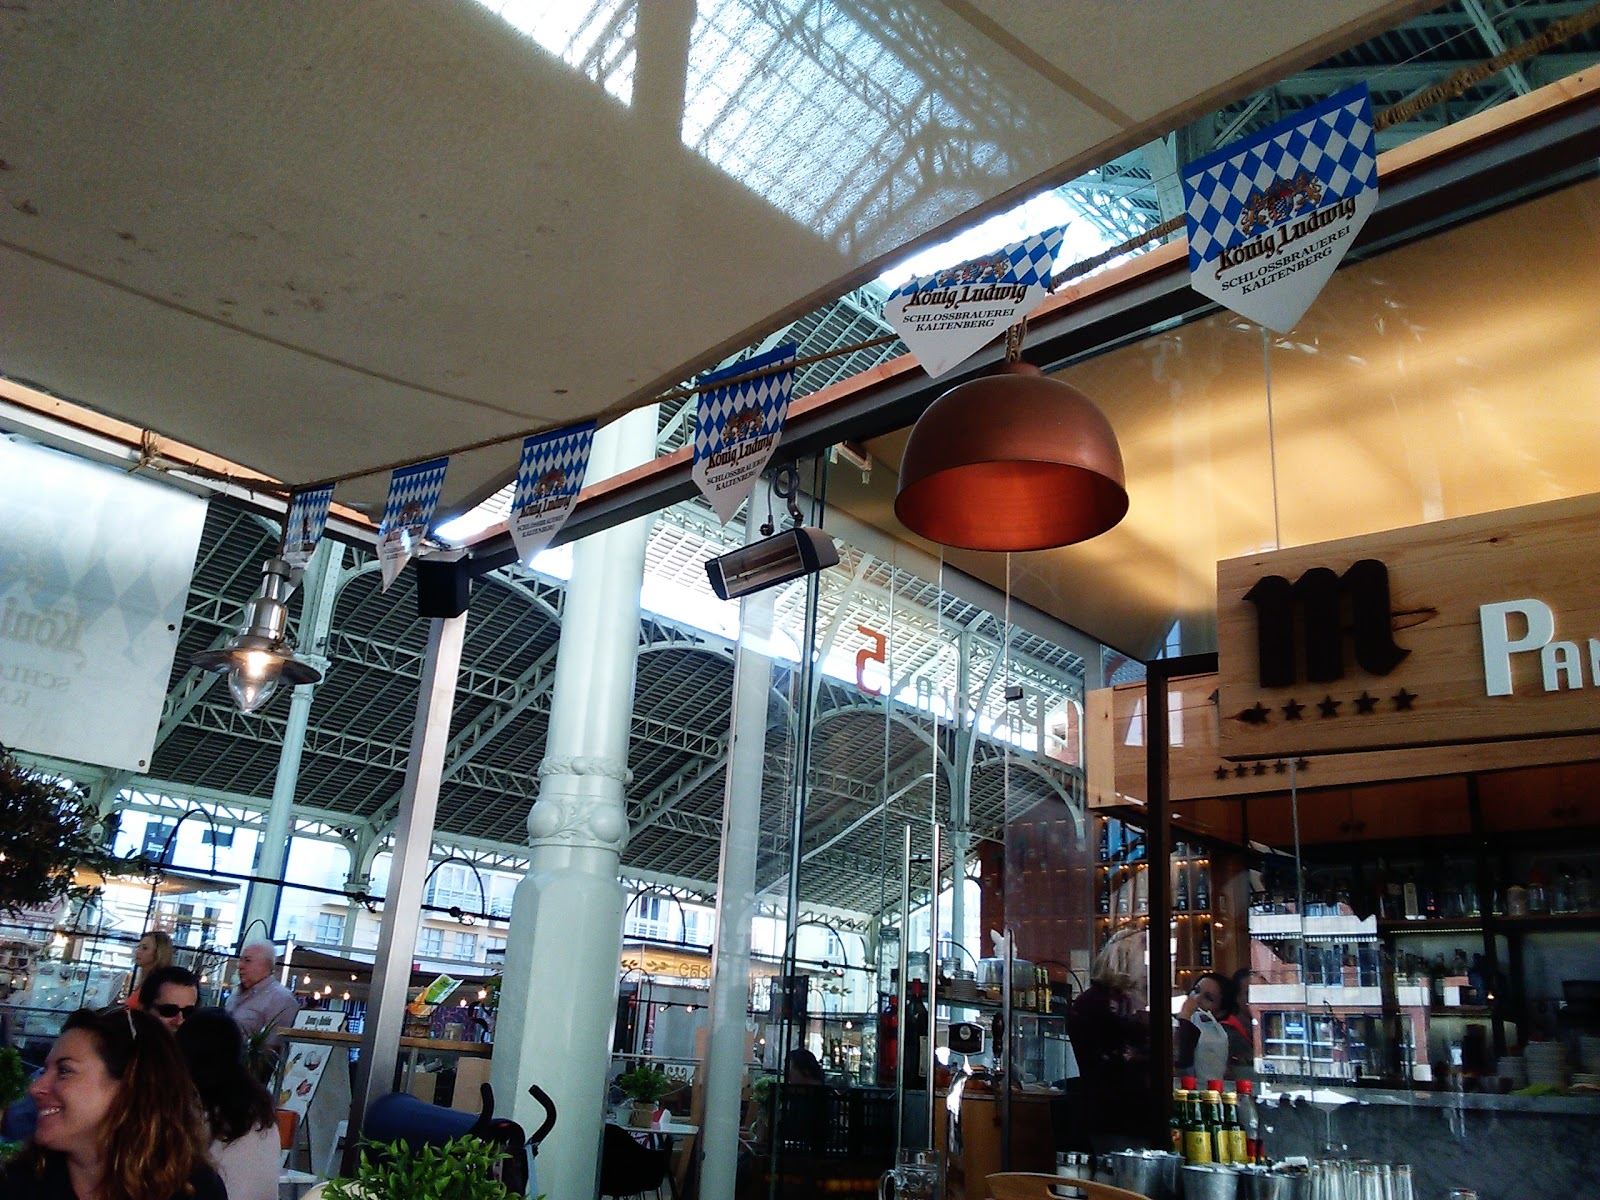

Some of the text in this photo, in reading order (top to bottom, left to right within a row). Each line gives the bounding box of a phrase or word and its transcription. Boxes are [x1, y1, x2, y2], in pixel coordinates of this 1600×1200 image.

[1214, 195, 1356, 280] König Ludwig
[1221, 225, 1351, 291] SCHLOSSBRAUEREI
[1241, 247, 1332, 295] KALTENBERG
[902, 280, 1027, 313] König Ludwig
[903, 308, 1015, 324] SCHLOSSBRAUEREI
[915, 319, 995, 332] KALTENBERG
[705, 447, 738, 475] König
[715, 471, 757, 492] KALTENBERG
